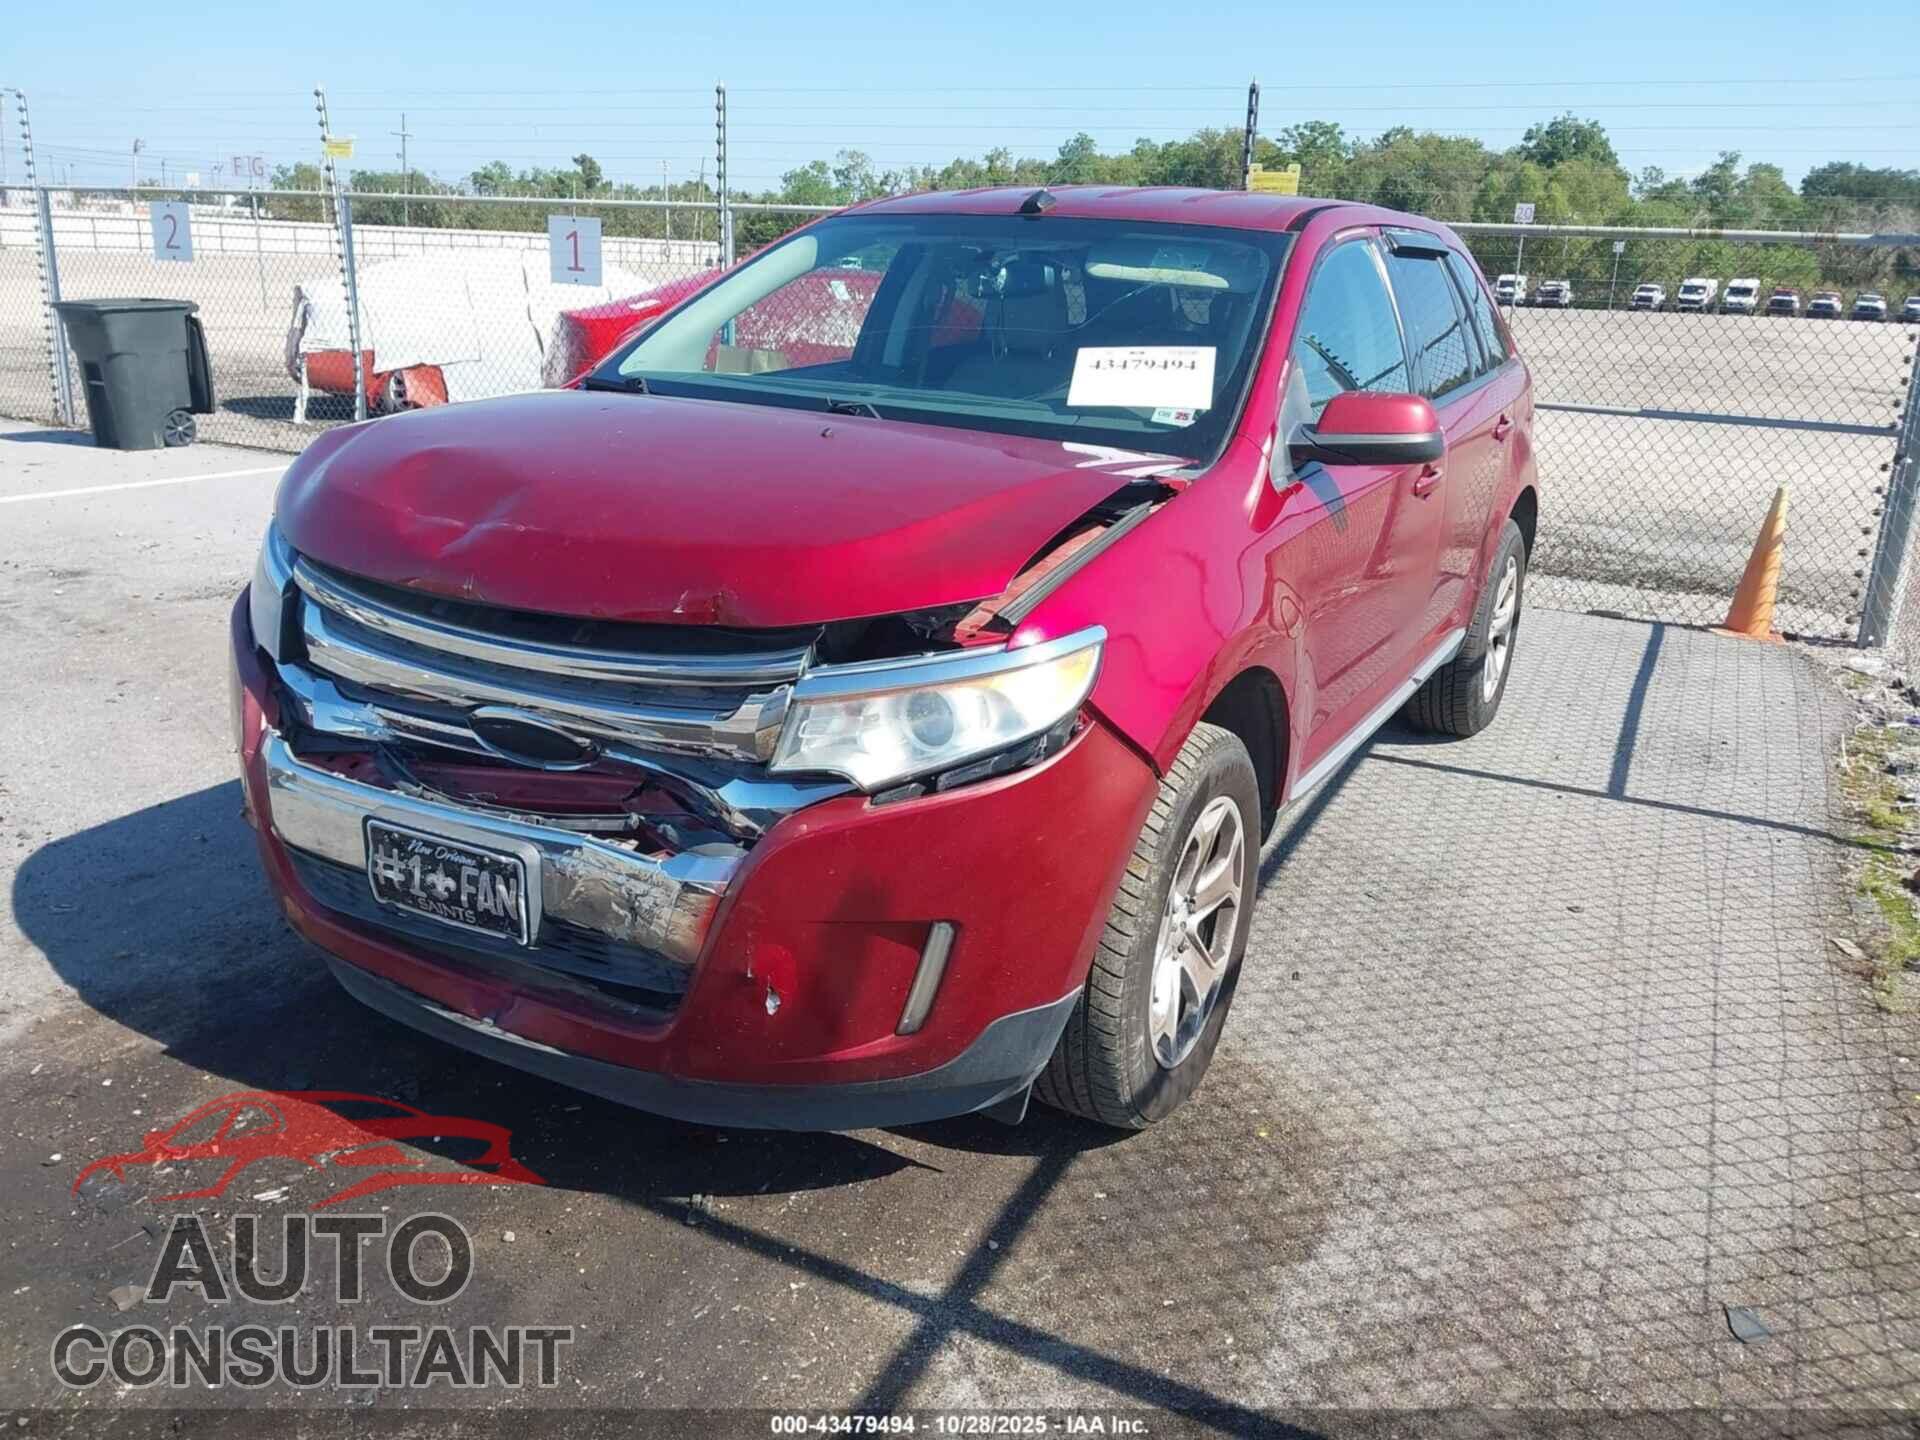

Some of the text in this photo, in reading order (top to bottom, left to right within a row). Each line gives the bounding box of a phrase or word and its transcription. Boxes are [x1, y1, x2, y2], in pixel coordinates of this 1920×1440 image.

[163, 214, 181, 249] 2
[566, 230, 585, 272] 1
[1089, 359, 1197, 371] 43479494
[1175, 411, 1191, 421] 25
[408, 839, 478, 866] New Orleans
[374, 844, 519, 921] #1 FAN
[418, 897, 476, 923] SAINTS
